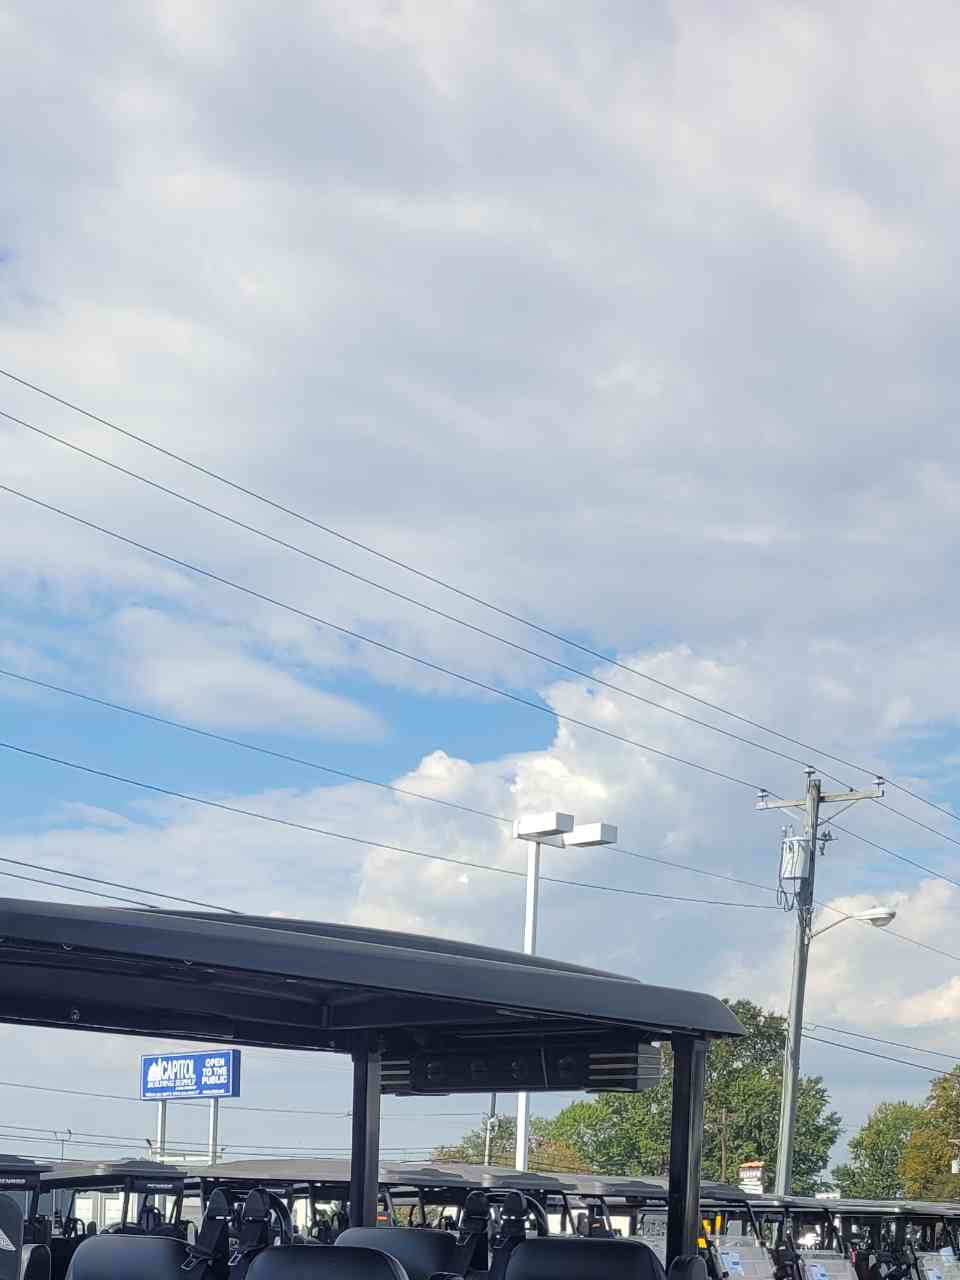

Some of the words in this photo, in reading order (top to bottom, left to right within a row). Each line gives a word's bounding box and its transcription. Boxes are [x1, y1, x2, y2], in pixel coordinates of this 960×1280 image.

[205, 1058, 224, 1067] OPEN
[161, 1059, 196, 1081] CAPITOL
[202, 1067, 212, 1076] TO
[213, 1066, 227, 1075] THE
[202, 1075, 227, 1085] PUBLIC
